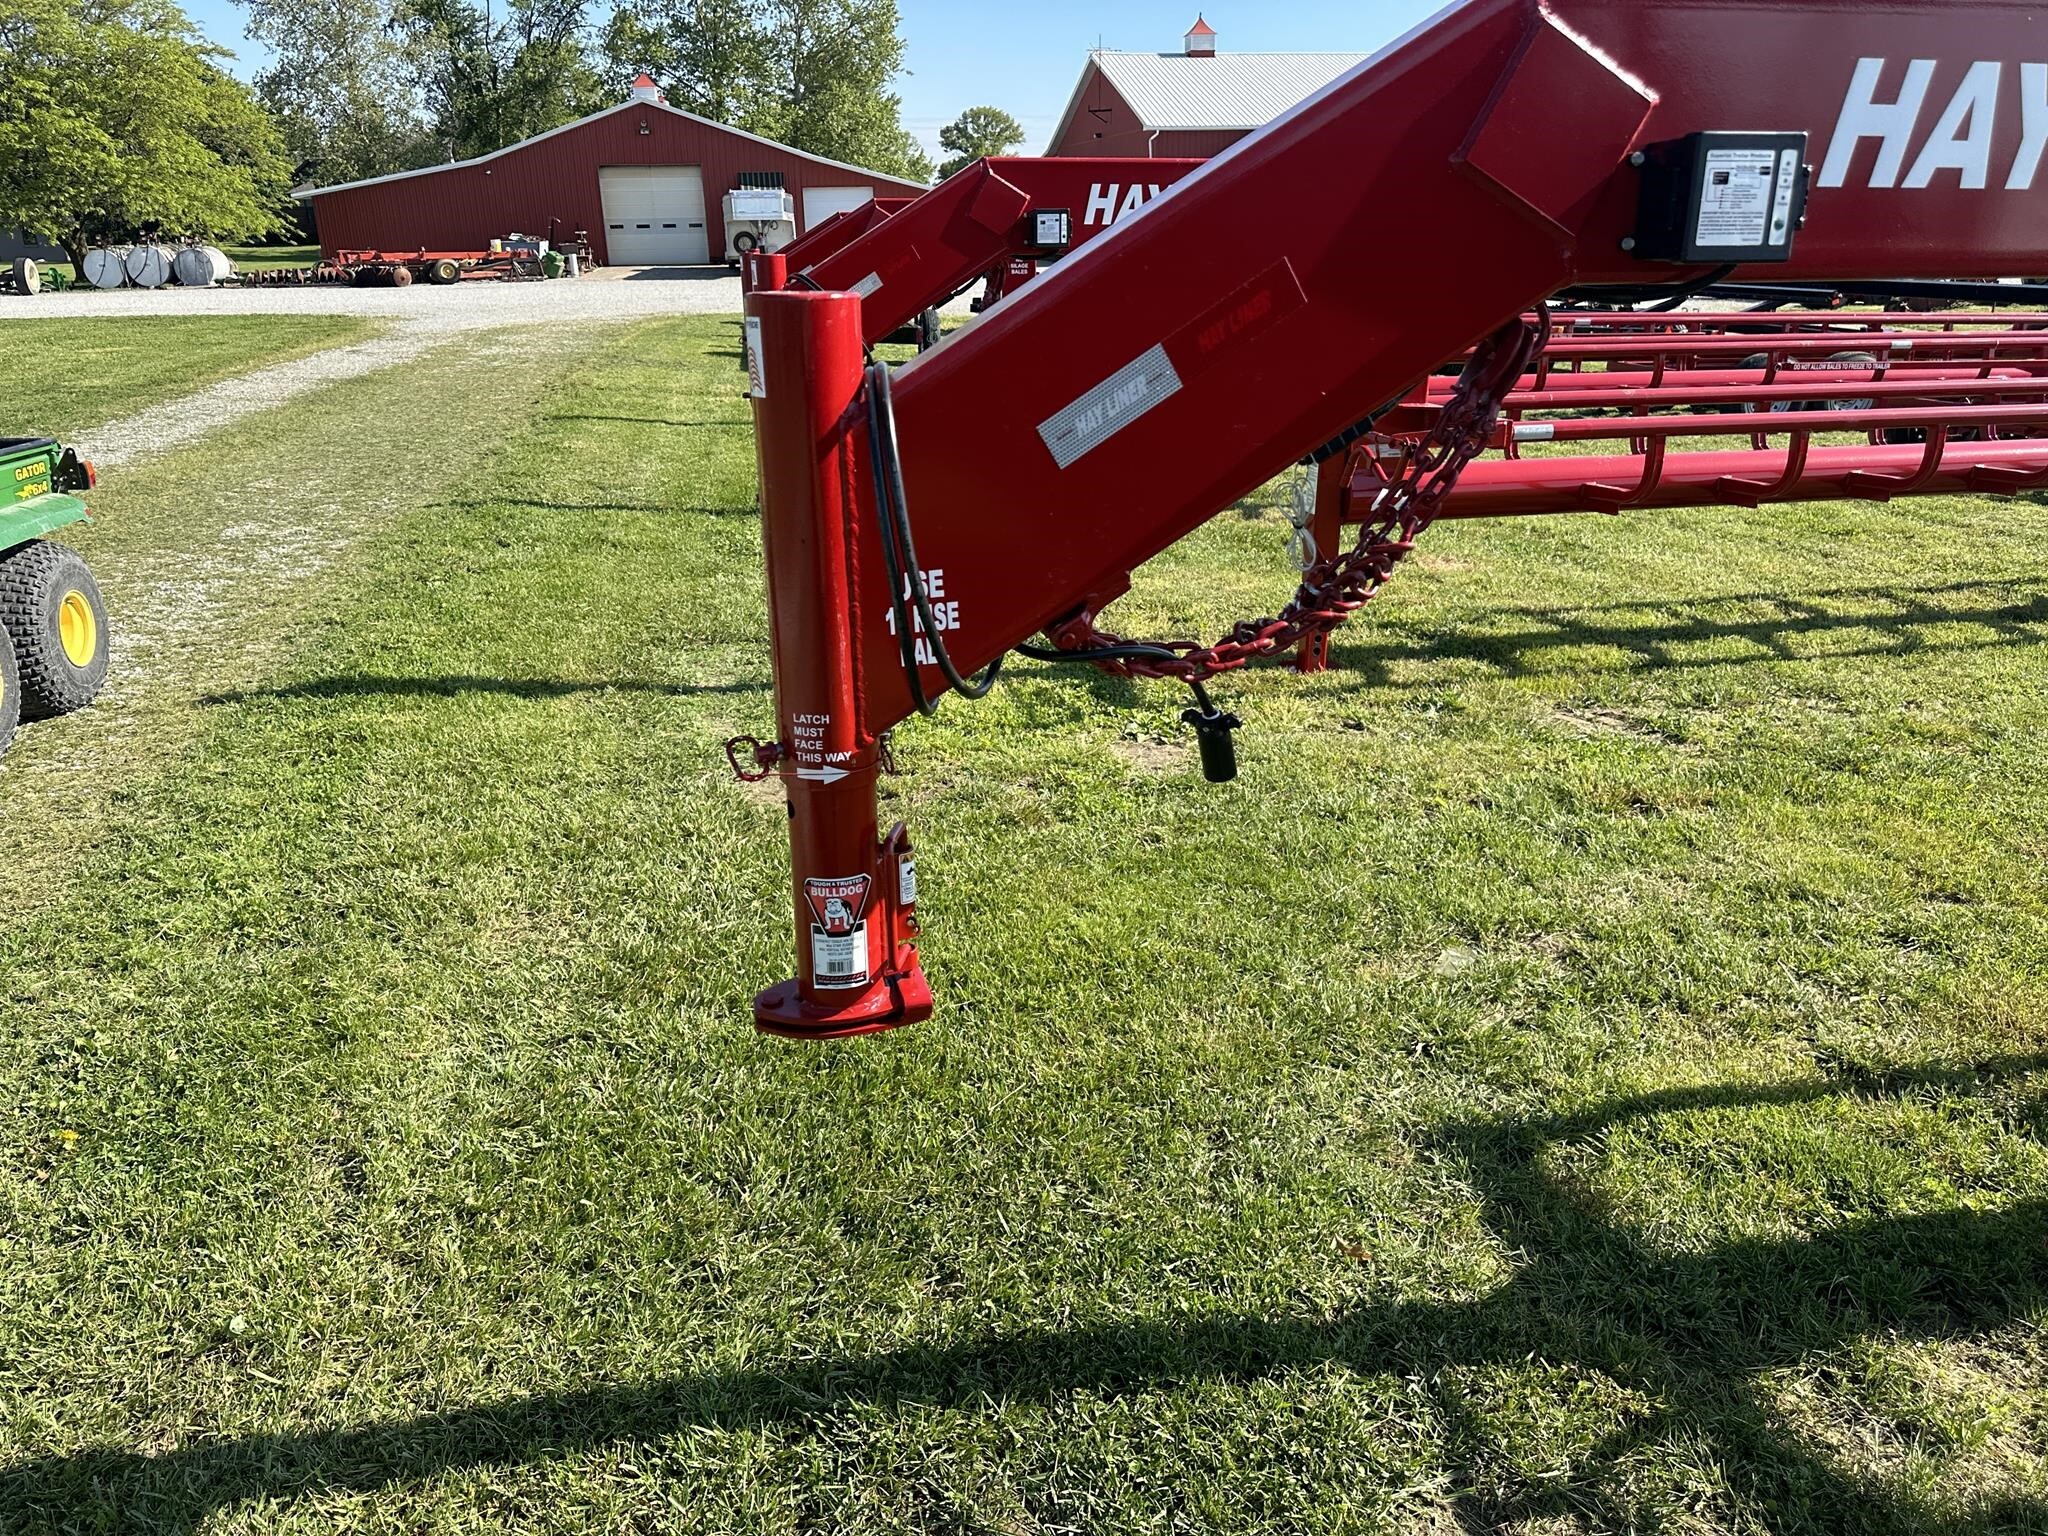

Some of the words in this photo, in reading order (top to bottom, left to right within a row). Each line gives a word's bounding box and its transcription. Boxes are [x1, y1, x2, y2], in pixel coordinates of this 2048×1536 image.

[1816, 57, 2048, 190] HAY
[1793, 362, 1800, 370] DO
[1801, 362, 1811, 370] NOT
[1811, 362, 1826, 370] ALLOW
[1827, 362, 1841, 370] BALES
[1842, 362, 1849, 370] TO
[1849, 362, 1865, 370] FREEZE
[1866, 362, 1872, 370] TO
[1873, 362, 1890, 370] TRAILER
[1075, 404, 1103, 438] HAY
[1105, 374, 1147, 418] LINER
[15, 462, 46, 481] GATOR
[901, 636, 950, 667] AL
[793, 713, 830, 725] LATCH
[793, 726, 825, 738] MUST
[794, 739, 824, 750] FACE
[796, 751, 822, 763] THIS
[824, 751, 852, 763] WAY
[836, 878, 863, 887] TRUSTED
[811, 884, 863, 897] BULLDOG
